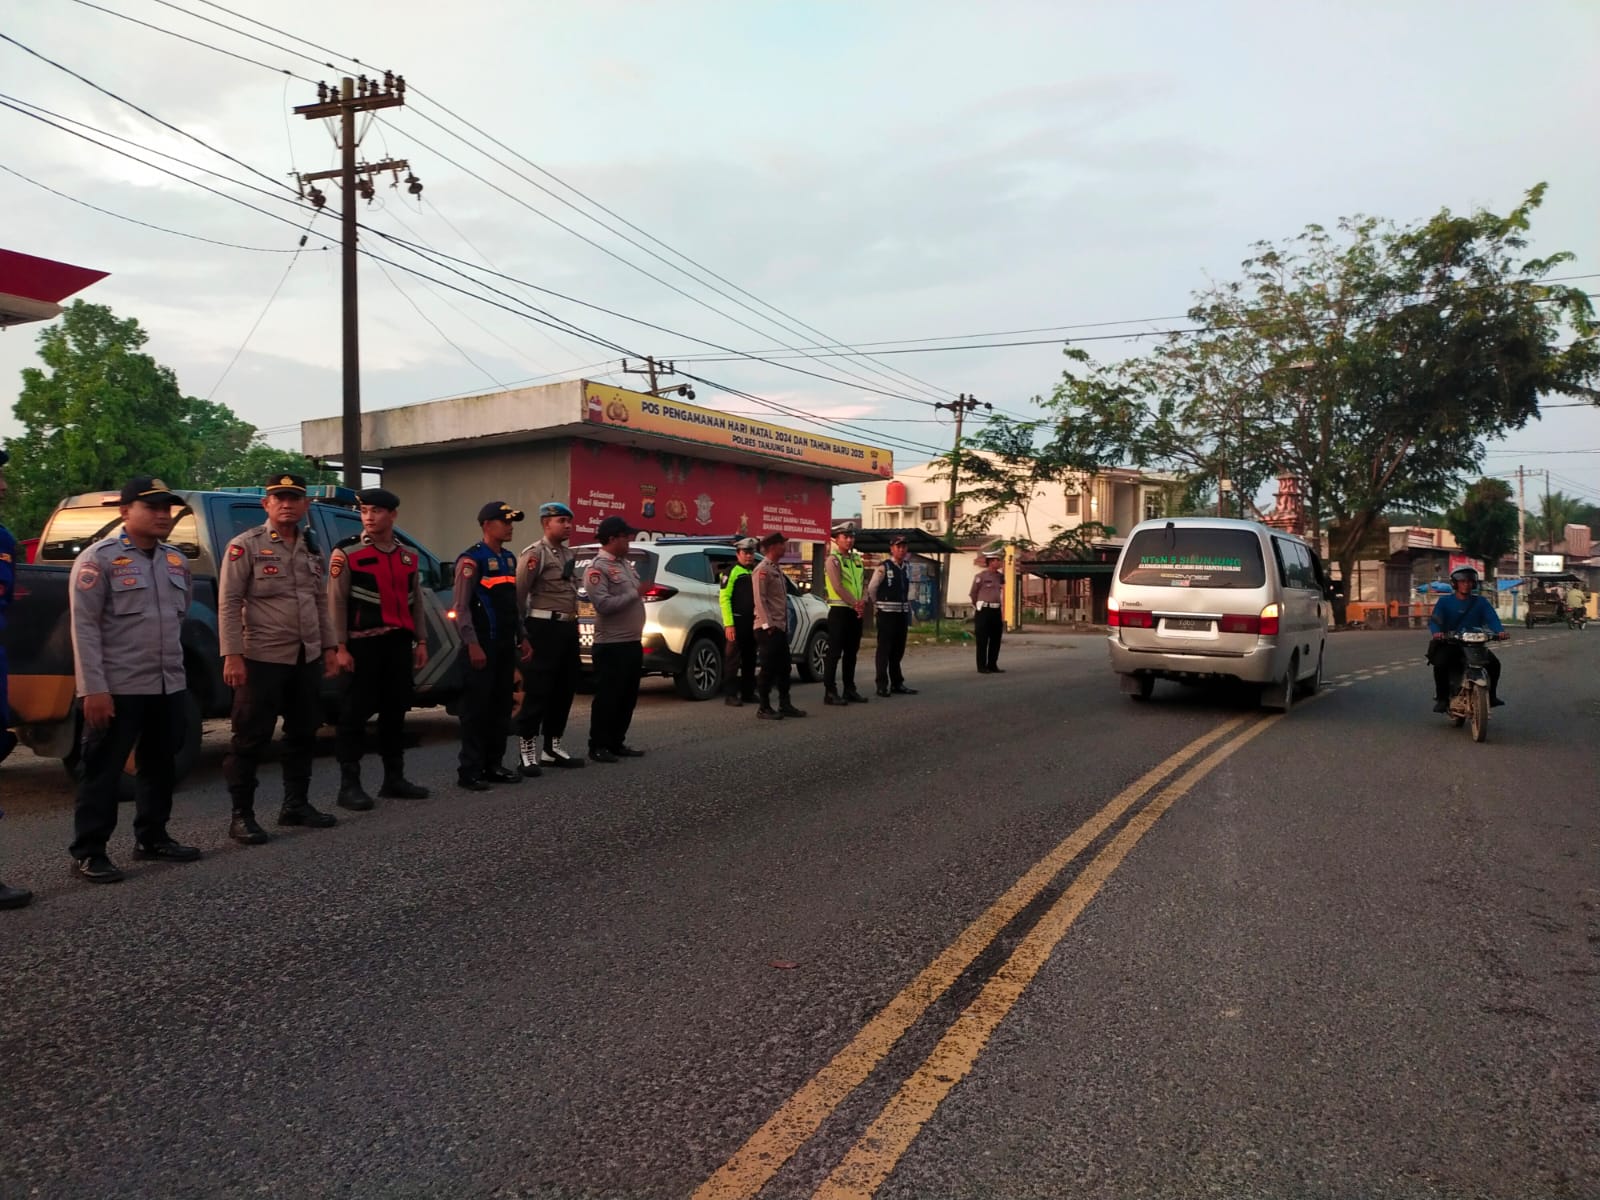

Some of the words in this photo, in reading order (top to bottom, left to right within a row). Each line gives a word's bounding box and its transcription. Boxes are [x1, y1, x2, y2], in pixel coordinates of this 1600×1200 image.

[641, 401, 660, 415] POS
[663, 406, 725, 429] PENGAMANAN
[728, 420, 747, 434] HARI
[750, 426, 773, 439] NATAL
[776, 431, 792, 443] 2024
[794, 435, 808, 446] DAN
[810, 439, 831, 451] TAHUN
[833, 444, 849, 455] BARU
[851, 448, 864, 458] 2025
[732, 435, 756, 447] POLRES
[758, 440, 784, 452] TANJUNG
[786, 446, 803, 456] BALAI
[578, 497, 591, 506] Hari
[593, 499, 609, 508] Natal
[590, 490, 614, 500] Selamat
